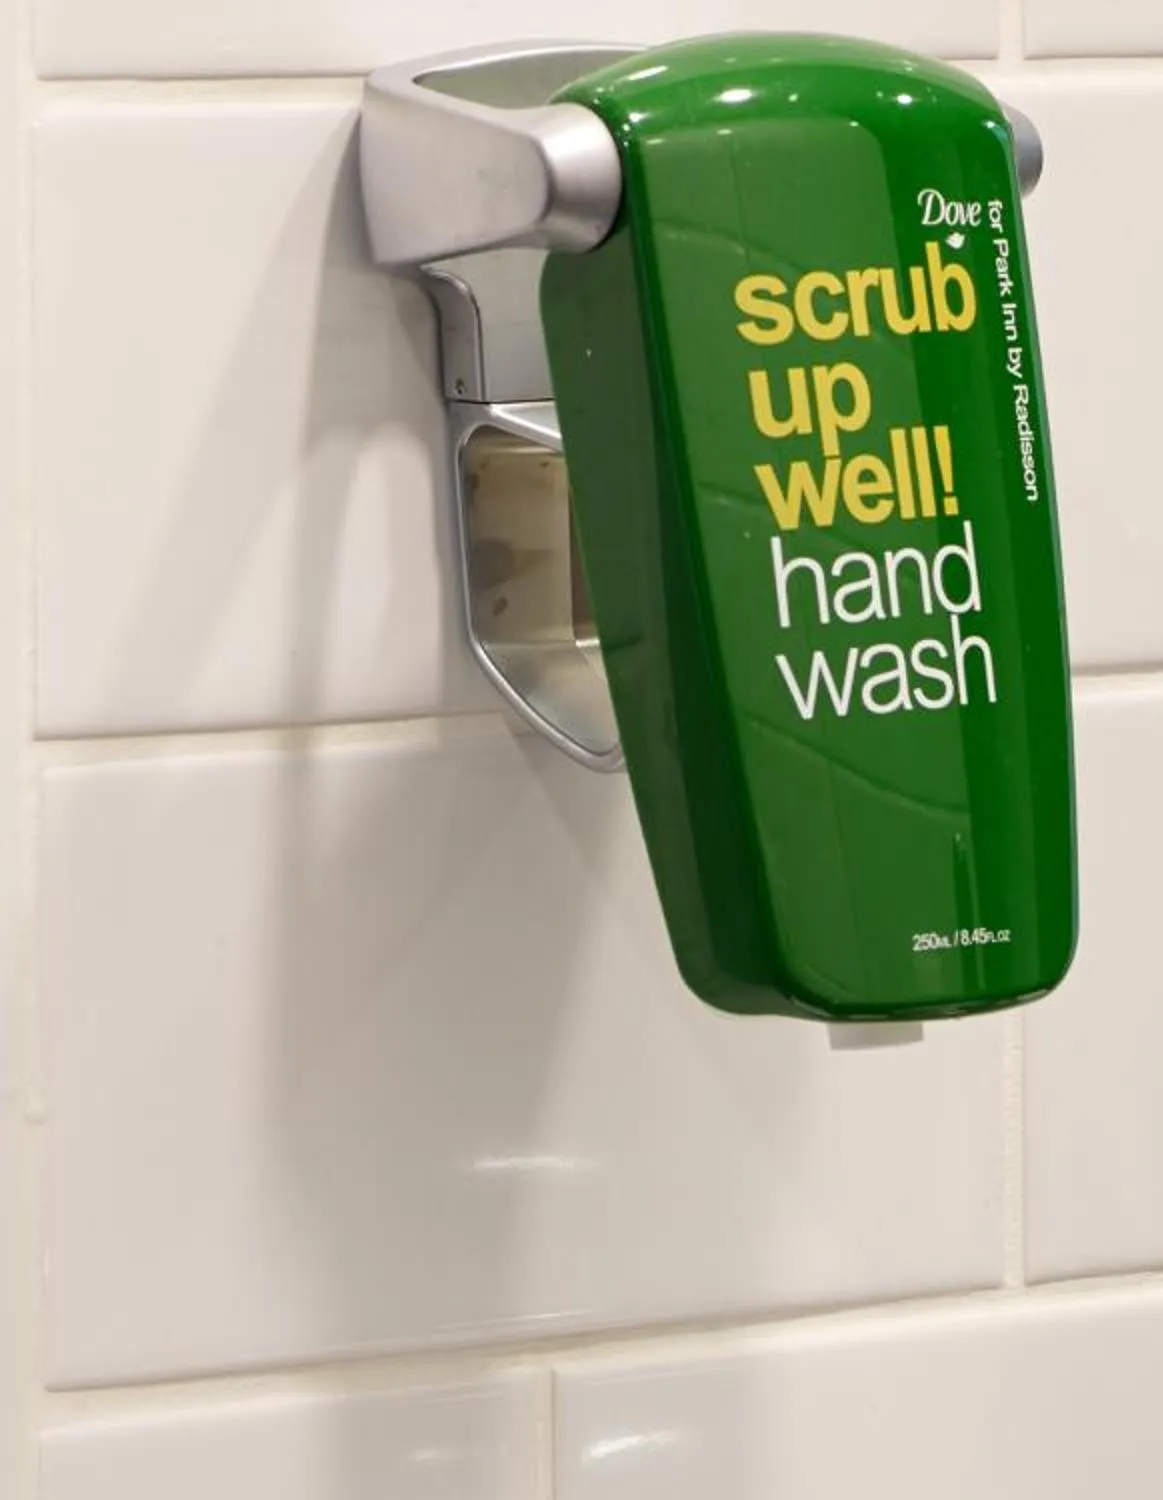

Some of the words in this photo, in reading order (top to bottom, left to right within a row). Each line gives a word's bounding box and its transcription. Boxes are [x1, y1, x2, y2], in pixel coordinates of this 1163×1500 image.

[917, 188, 982, 227] Dove
[988, 199, 1004, 233] for
[733, 240, 977, 346] scrub
[993, 238, 1013, 297] Park
[1001, 302, 1018, 342] Inn
[1006, 346, 1023, 379] by
[748, 361, 872, 458] up
[1013, 383, 1039, 503] Radisson
[752, 425, 960, 531] well!
[770, 520, 982, 629] hand
[775, 614, 997, 720] wash
